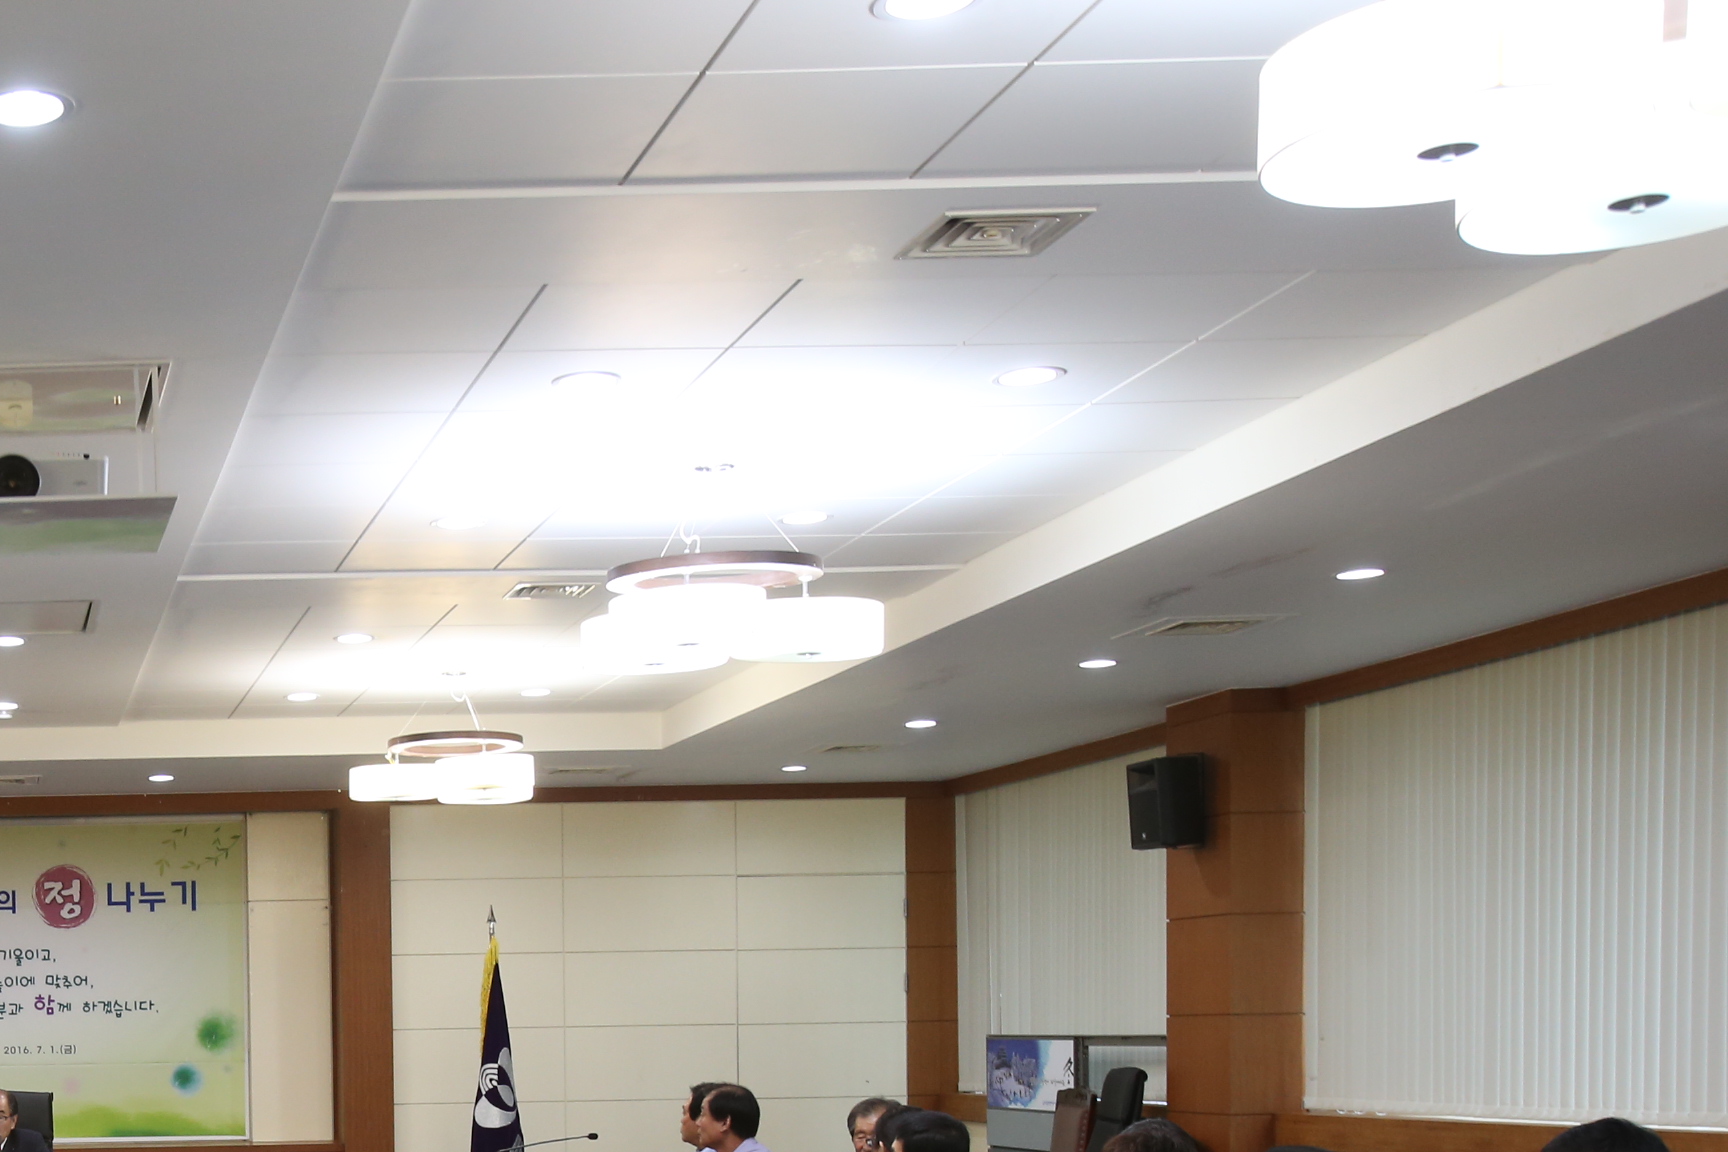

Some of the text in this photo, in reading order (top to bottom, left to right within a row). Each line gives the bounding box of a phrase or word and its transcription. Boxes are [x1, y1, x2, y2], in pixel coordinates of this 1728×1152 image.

[43, 878, 83, 920] 정
[106, 880, 198, 913] 나누기
[44, 974, 94, 990] 맞추어,
[34, 994, 72, 1016] 함께
[82, 1000, 159, 1019] 하겠습니다.
[3, 1045, 32, 1055] 2016.
